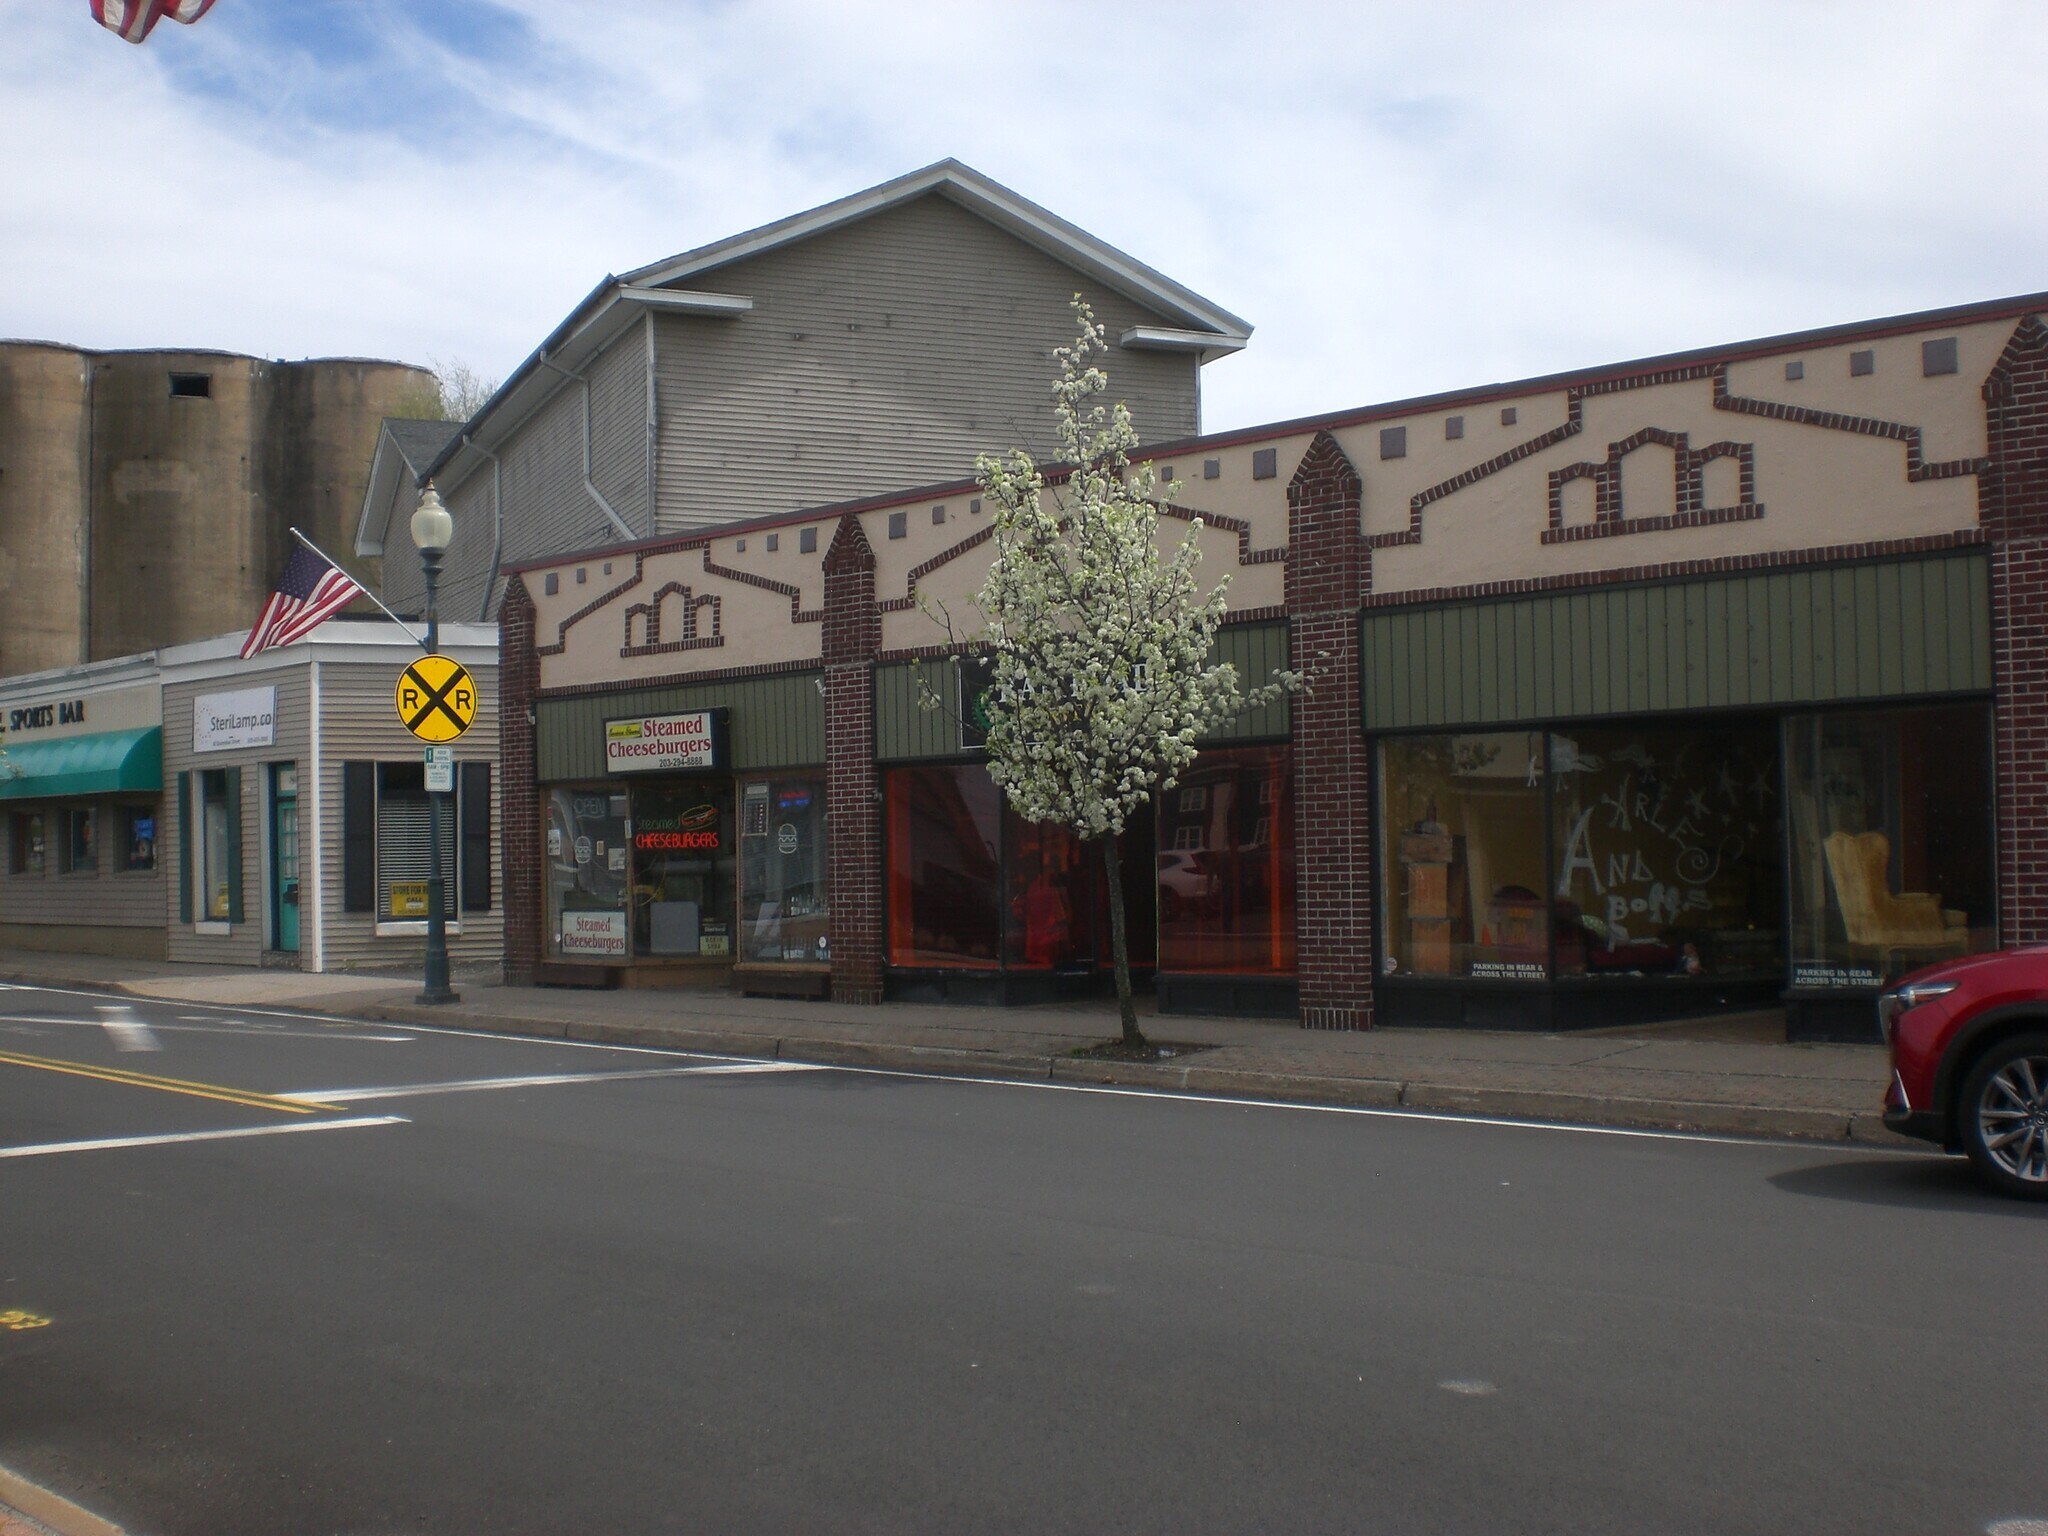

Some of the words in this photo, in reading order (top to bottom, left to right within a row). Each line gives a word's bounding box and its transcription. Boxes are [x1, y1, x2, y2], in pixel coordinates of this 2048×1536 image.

[402, 688, 419, 710] R
[455, 689, 471, 710] R
[10, 704, 54, 731] SPORTS
[58, 699, 85, 725] BAR
[210, 713, 272, 732] SteriLamp.co
[643, 715, 703, 738] Steamed
[608, 738, 711, 758] Cheeseburgers
[634, 832, 719, 848] CHEESEBURGERS
[576, 917, 611, 932] Steamed
[563, 933, 624, 953] Cheeseburgers
[1471, 970, 1500, 978] ACROSS
[1518, 971, 1546, 979] STREET
[1795, 977, 1829, 985] ACROSS
[1832, 977, 1849, 985] THE
[1851, 978, 1885, 986] STREET
[1797, 968, 1835, 977] PARKING
[1848, 969, 1873, 978] REAR
